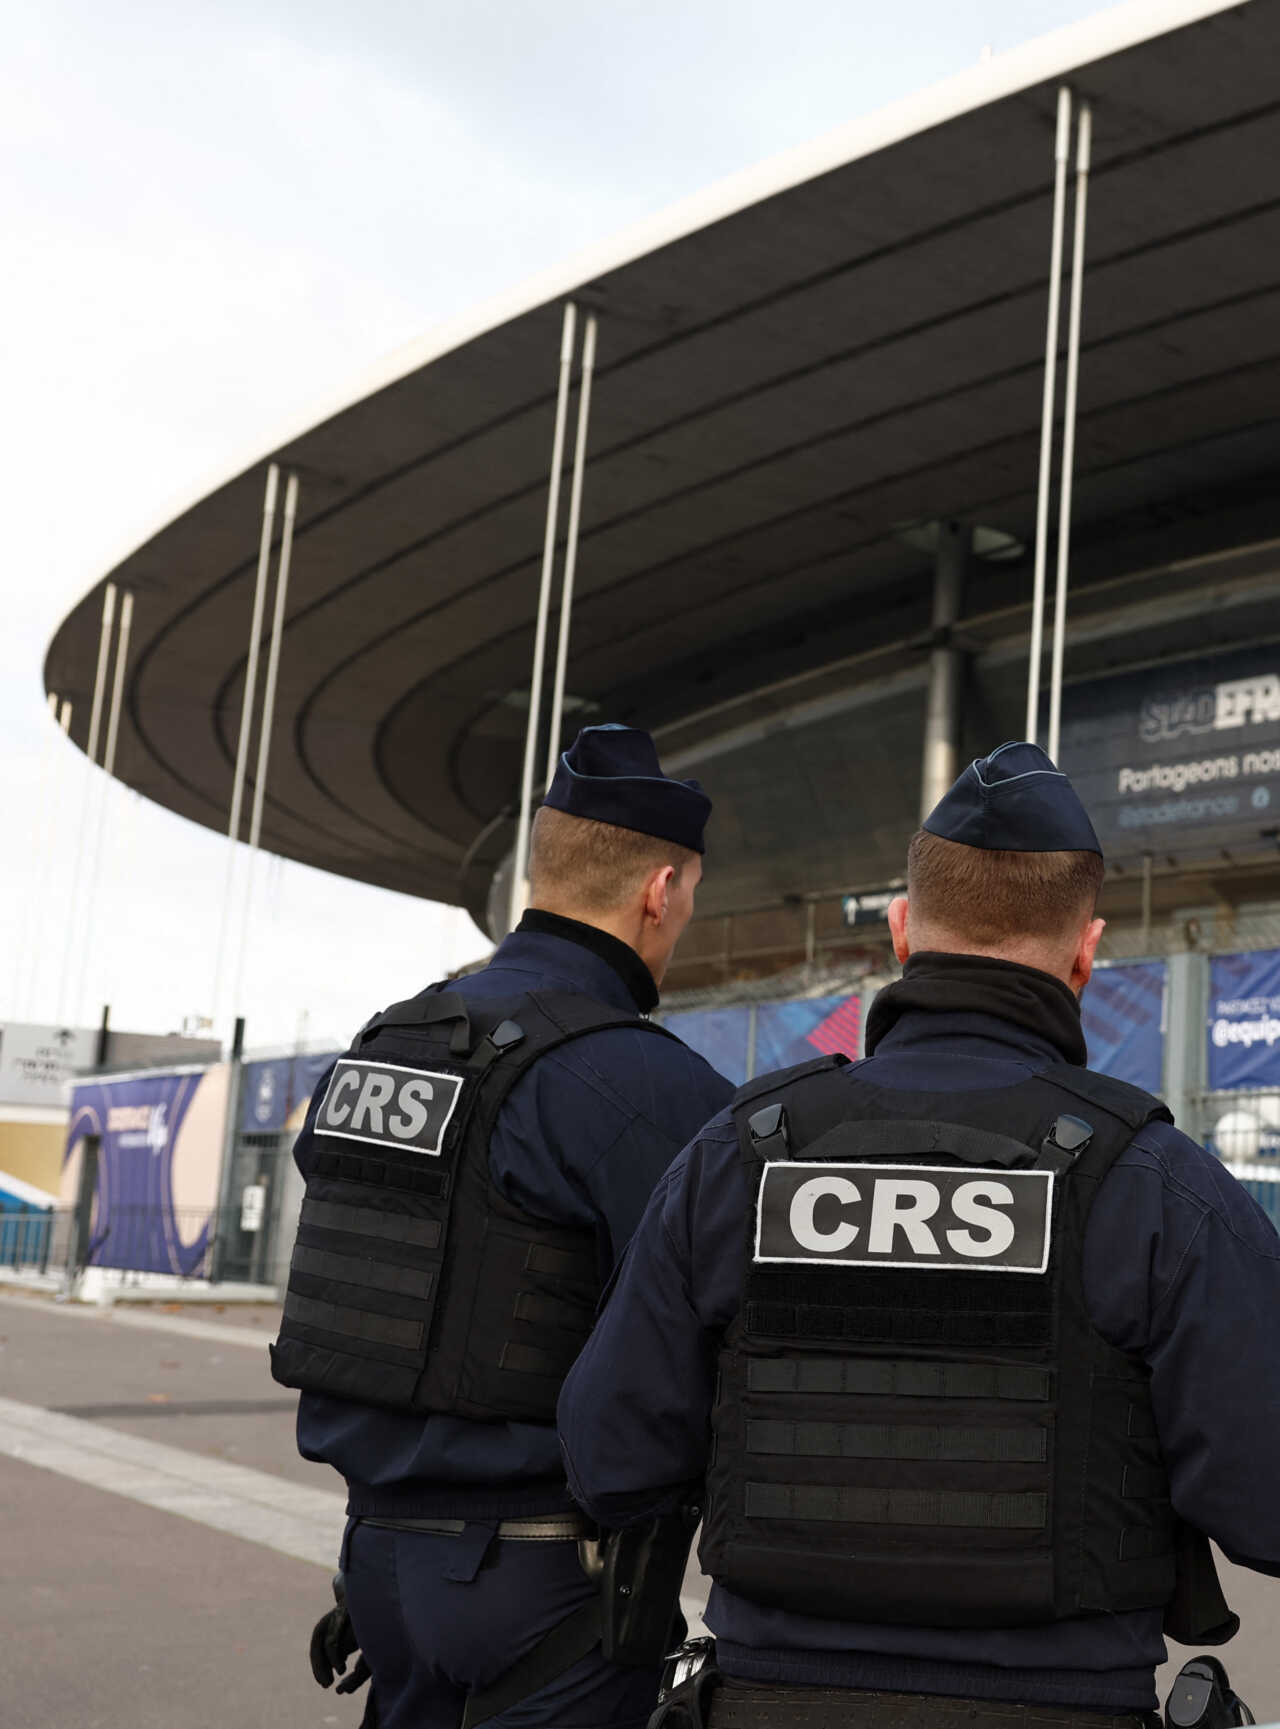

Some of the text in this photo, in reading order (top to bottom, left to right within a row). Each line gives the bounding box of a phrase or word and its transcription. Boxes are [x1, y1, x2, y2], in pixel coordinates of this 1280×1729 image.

[1118, 757, 1238, 793] Partageons
[326, 1070, 434, 1139] CRS
[789, 1176, 1015, 1258] CRS
